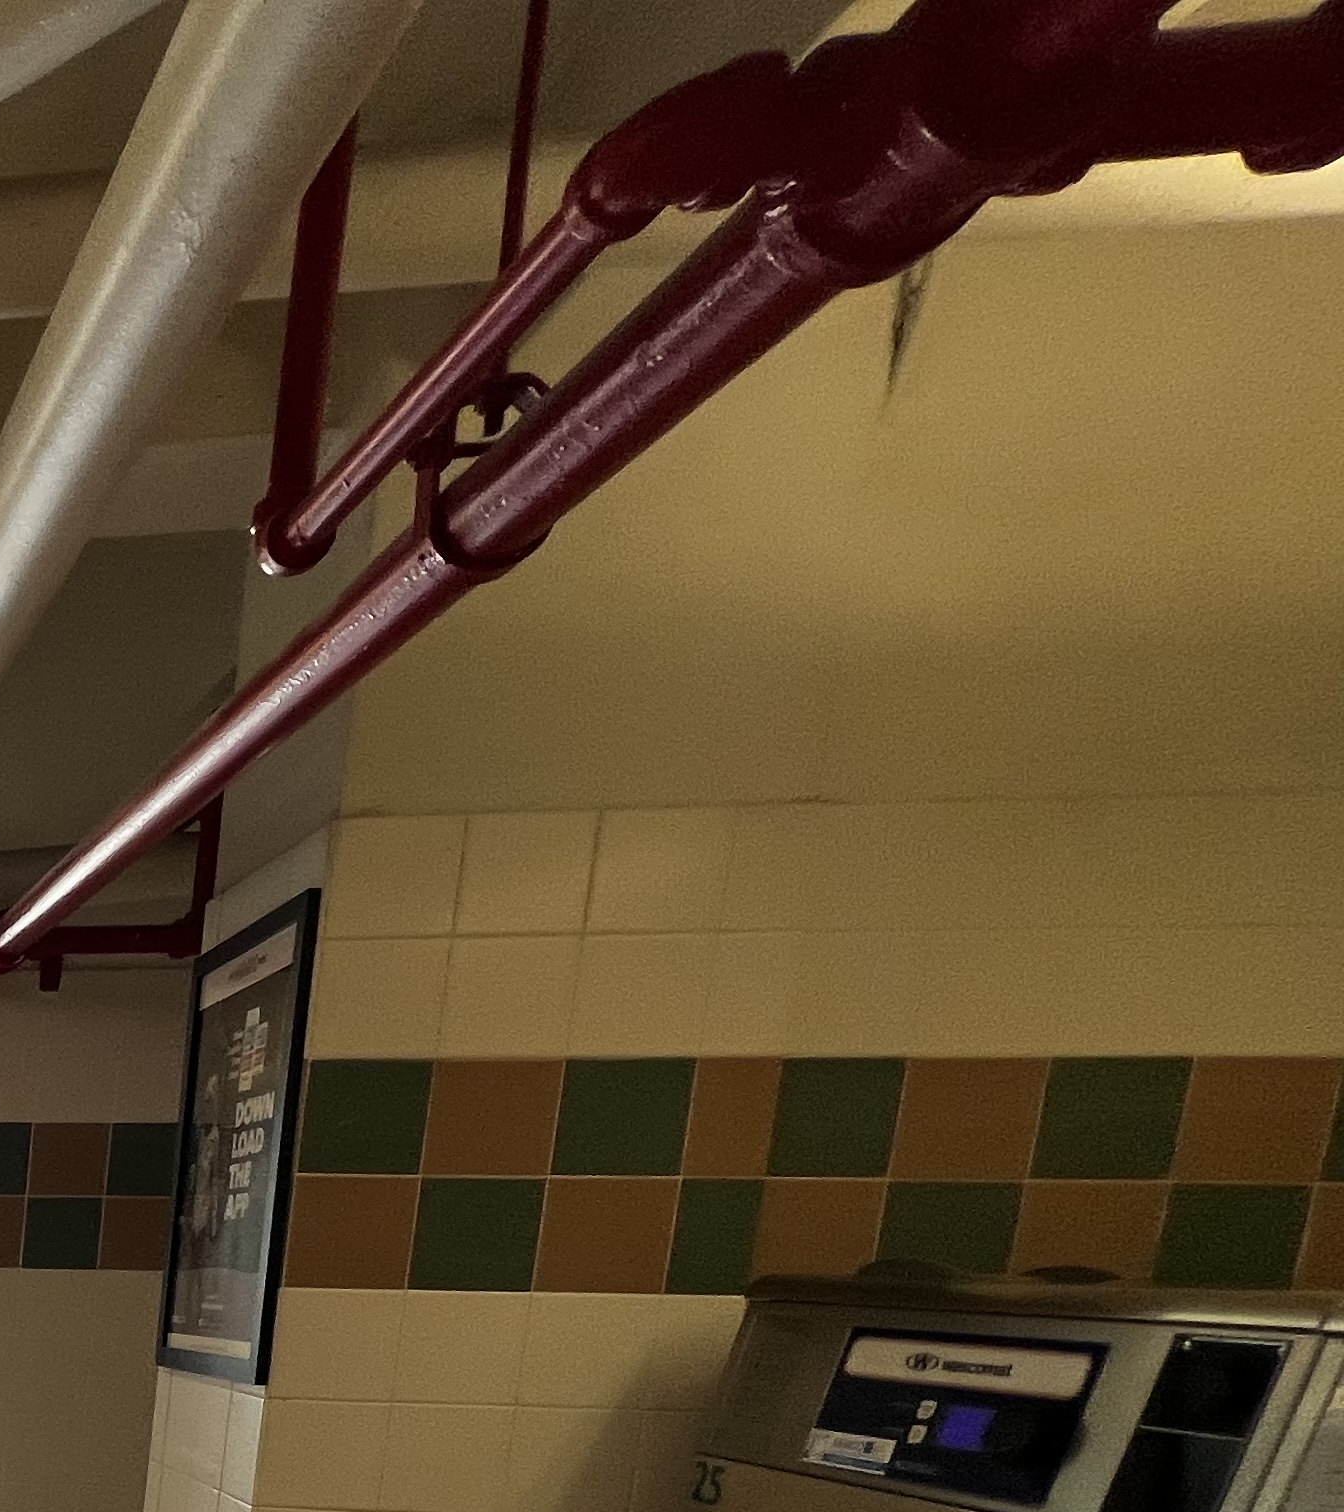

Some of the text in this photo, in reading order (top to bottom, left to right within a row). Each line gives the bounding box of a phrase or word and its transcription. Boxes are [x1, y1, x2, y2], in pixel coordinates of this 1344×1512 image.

[235, 1090, 275, 1128] DOWN
[231, 1127, 265, 1159] LOAD
[229, 1160, 252, 1190] THE
[223, 1192, 250, 1221] APP
[692, 1460, 725, 1506] 25
